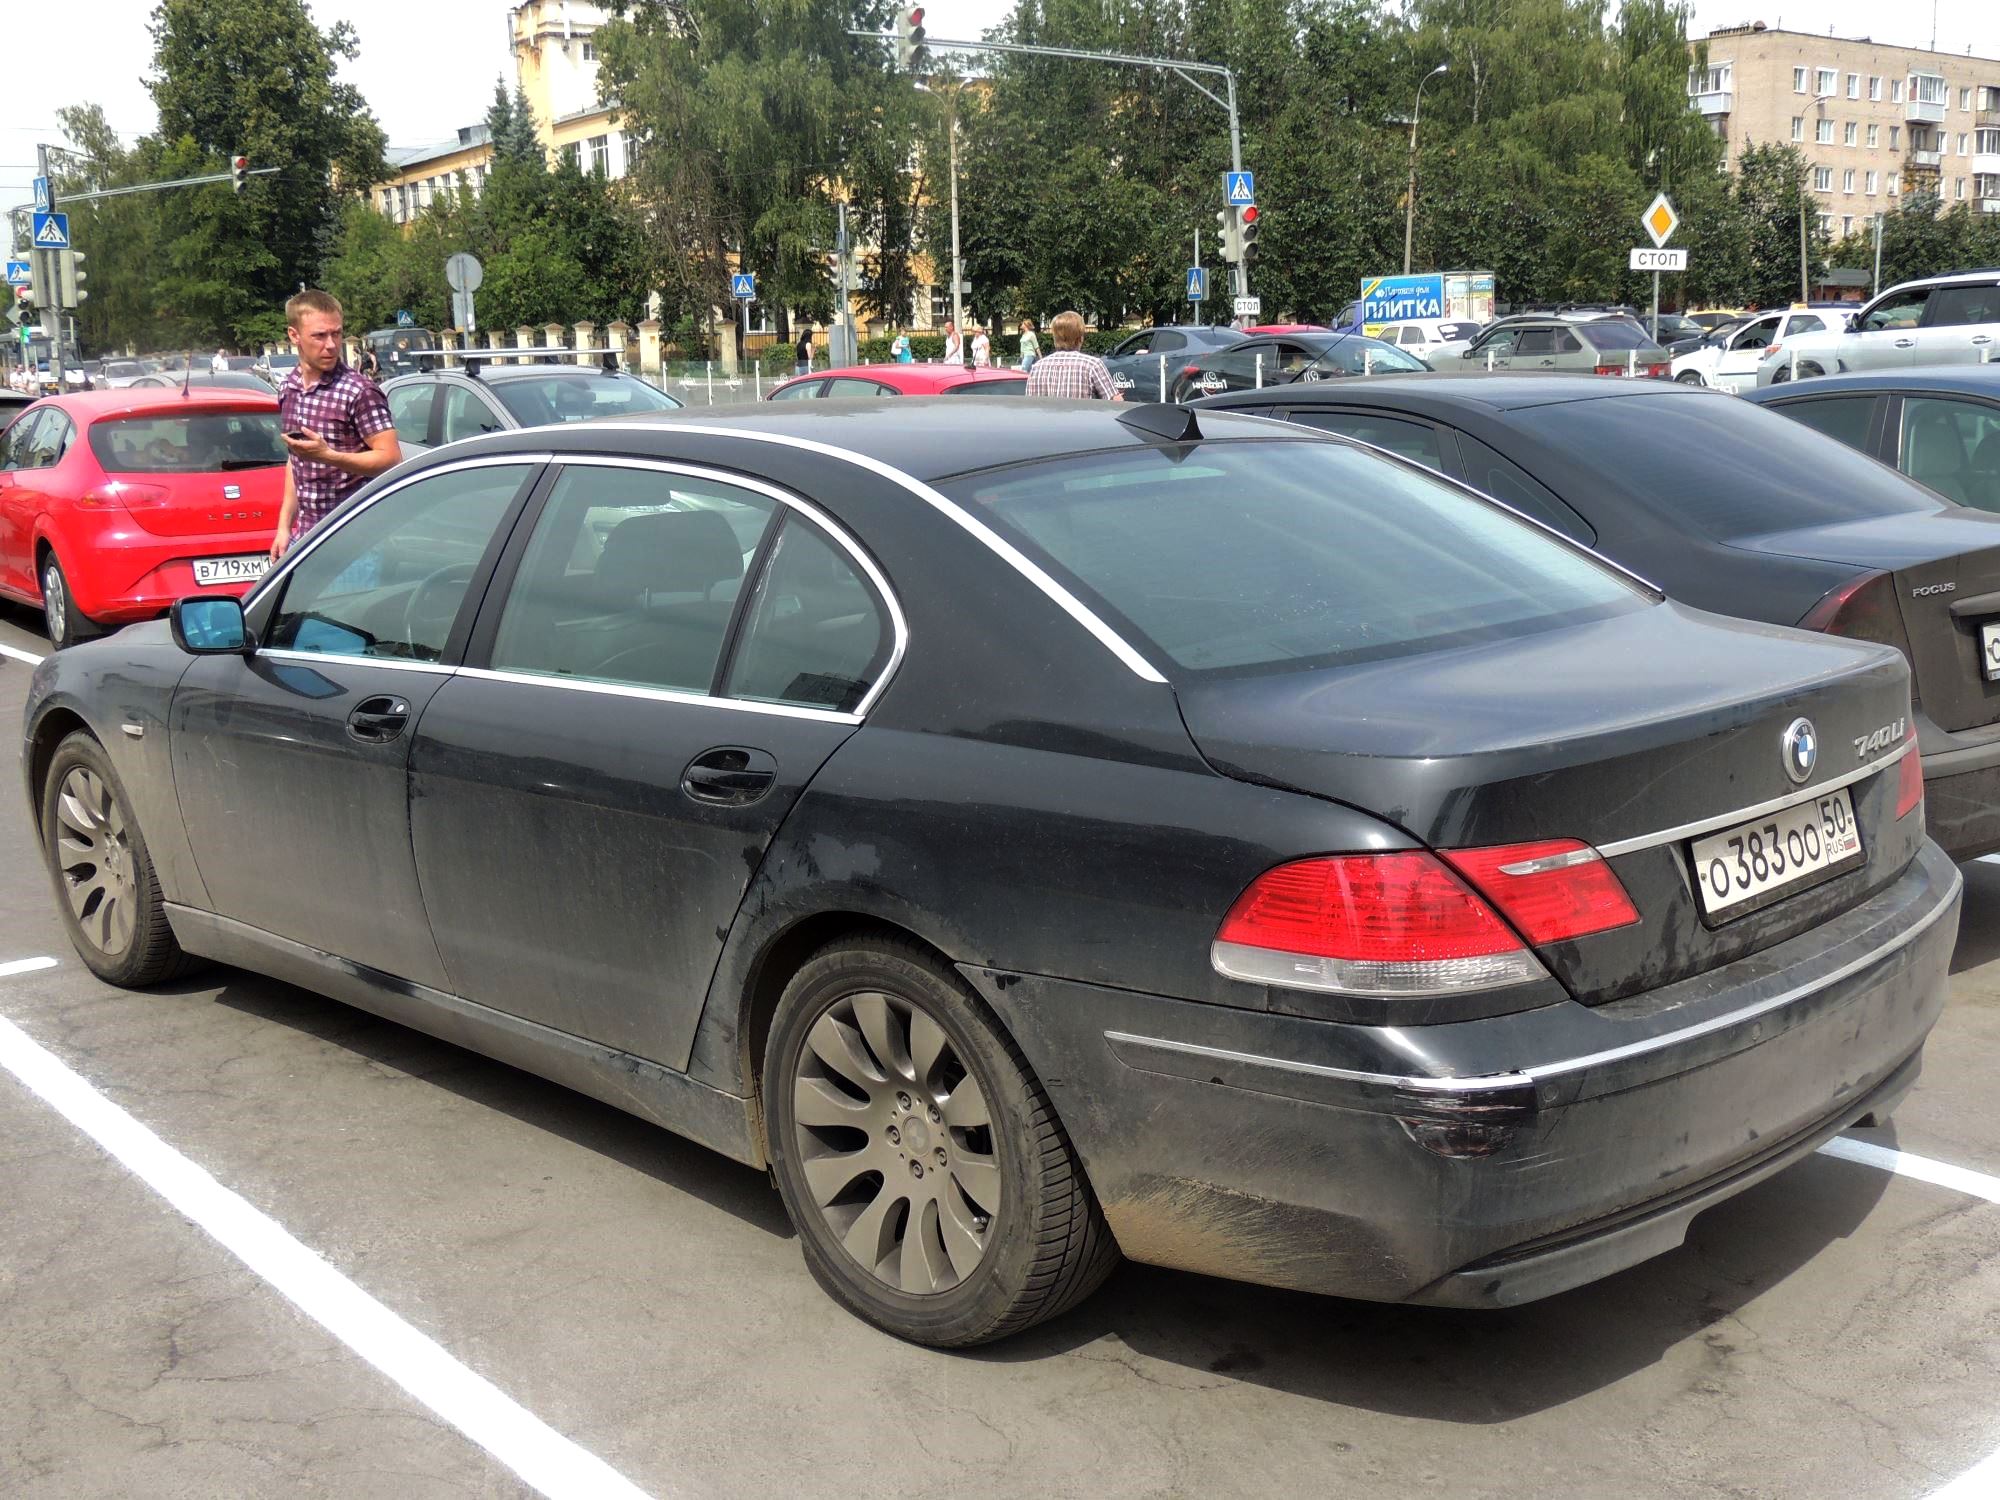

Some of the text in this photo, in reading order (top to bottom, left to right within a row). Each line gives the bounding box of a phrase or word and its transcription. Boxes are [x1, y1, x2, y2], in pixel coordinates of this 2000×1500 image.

[1639, 253, 1678, 266] СТОП
[1236, 301, 1259, 311] СТОП
[1365, 299, 1440, 318] ПЛИТКА
[208, 511, 262, 520] LEON
[1912, 583, 1956, 598] FOCUS
[1821, 797, 1847, 838] 50
[1826, 838, 1844, 856] RUS
